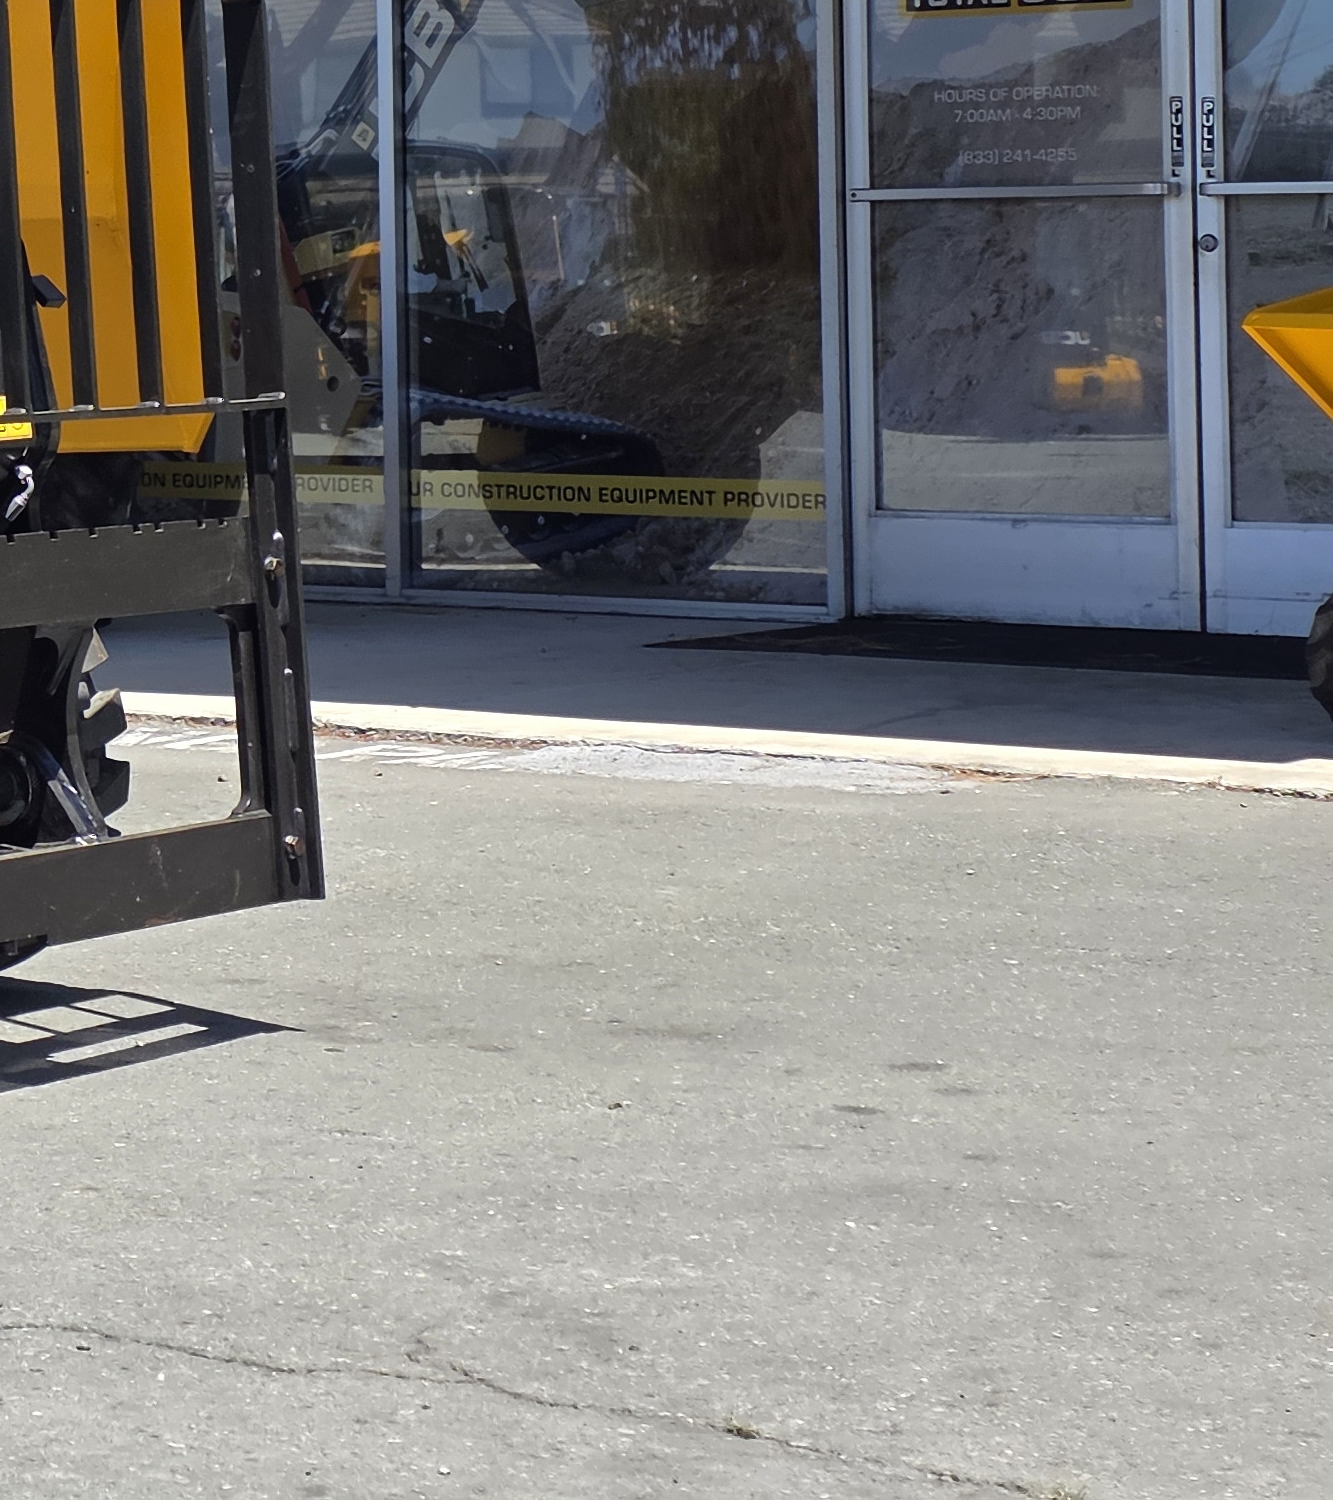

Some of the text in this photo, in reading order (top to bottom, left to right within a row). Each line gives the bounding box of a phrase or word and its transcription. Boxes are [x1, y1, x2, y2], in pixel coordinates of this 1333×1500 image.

[934, 88, 986, 103] HOURS
[989, 87, 1008, 101] OF
[954, 108, 1012, 123] 7:00AM
[1023, 106, 1082, 120] 4:30PM
[1171, 101, 1182, 151] PULL
[1203, 102, 1214, 151] PULL
[1003, 147, 1077, 163] 241-4255
[172, 473, 247, 490] EQUIPM
[296, 476, 374, 492] ROVIDER
[440, 481, 592, 504] CONSTRUCTION
[598, 486, 716, 507] EQUIPMENT
[724, 491, 827, 510] PROVIDER
